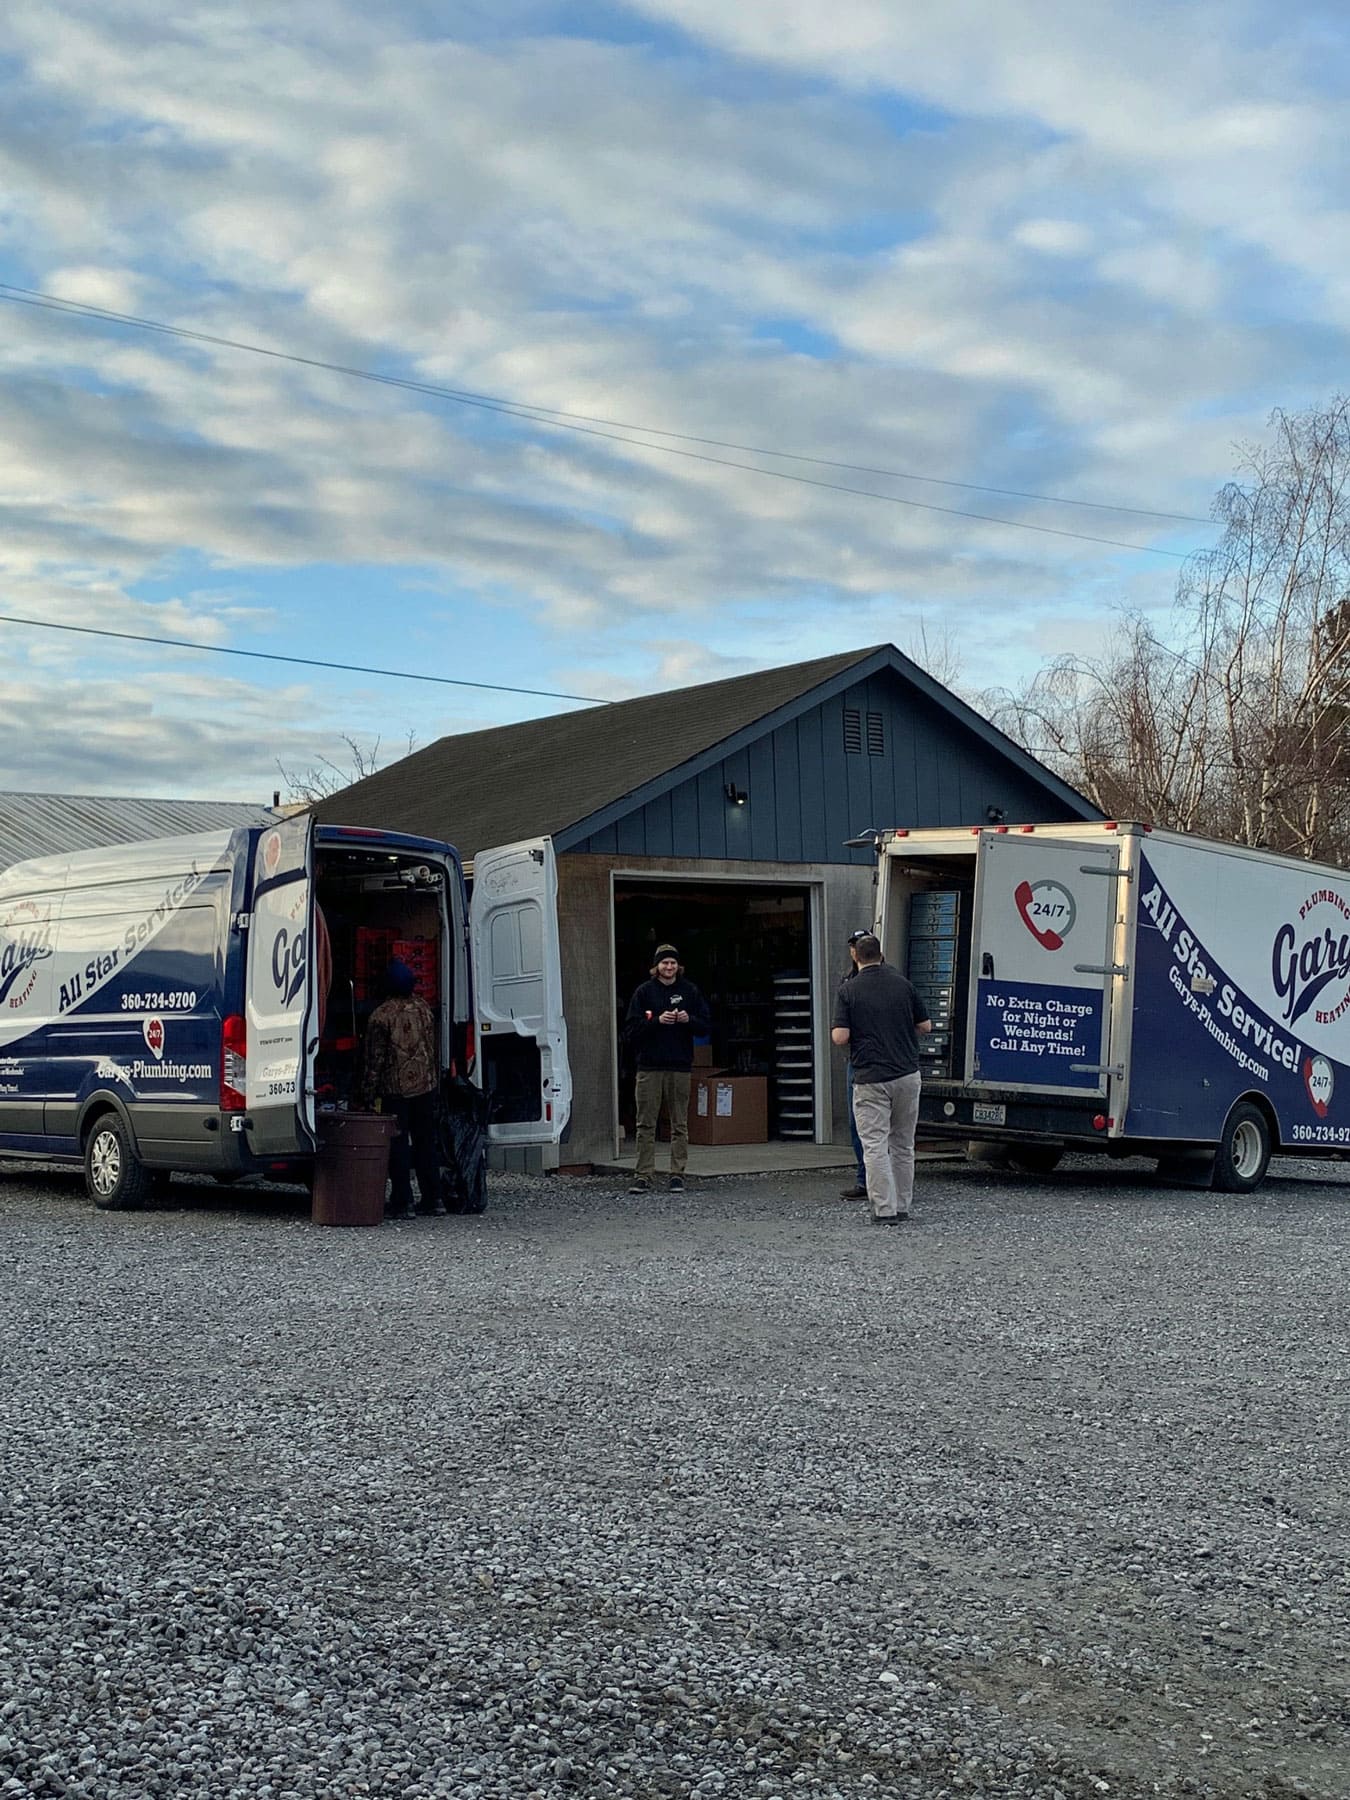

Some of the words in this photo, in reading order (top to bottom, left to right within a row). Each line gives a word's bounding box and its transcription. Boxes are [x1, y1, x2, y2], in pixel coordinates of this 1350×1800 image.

[1033, 902, 1065, 918] 24/7
[59, 973, 82, 1013] All
[85, 945, 120, 991] Star
[1141, 883, 1177, 942] All
[1217, 985, 1302, 1074] Service!
[1272, 923, 1350, 1027] Gary
[121, 991, 197, 1010] 360-734-9700
[987, 995, 1006, 1008] No
[1008, 996, 1043, 1011] Extra
[1046, 1000, 1093, 1017] Charge
[1002, 1010, 1022, 1023] for
[1023, 1012, 1060, 1028] Night
[1062, 1019, 1077, 1028] or
[1168, 965, 1269, 1082] Garys-Plumbing.com
[1003, 1025, 1073, 1041] Weekends!
[990, 1038, 1017, 1051] Call
[1020, 1040, 1046, 1056] Any
[1047, 1043, 1086, 1057] Time!
[97, 1060, 212, 1083] Garys-Plumbing.com
[269, 1081, 296, 1096] 360-73
[1312, 1075, 1329, 1088] 24/7
[1292, 1124, 1350, 1142] 360-734-97
